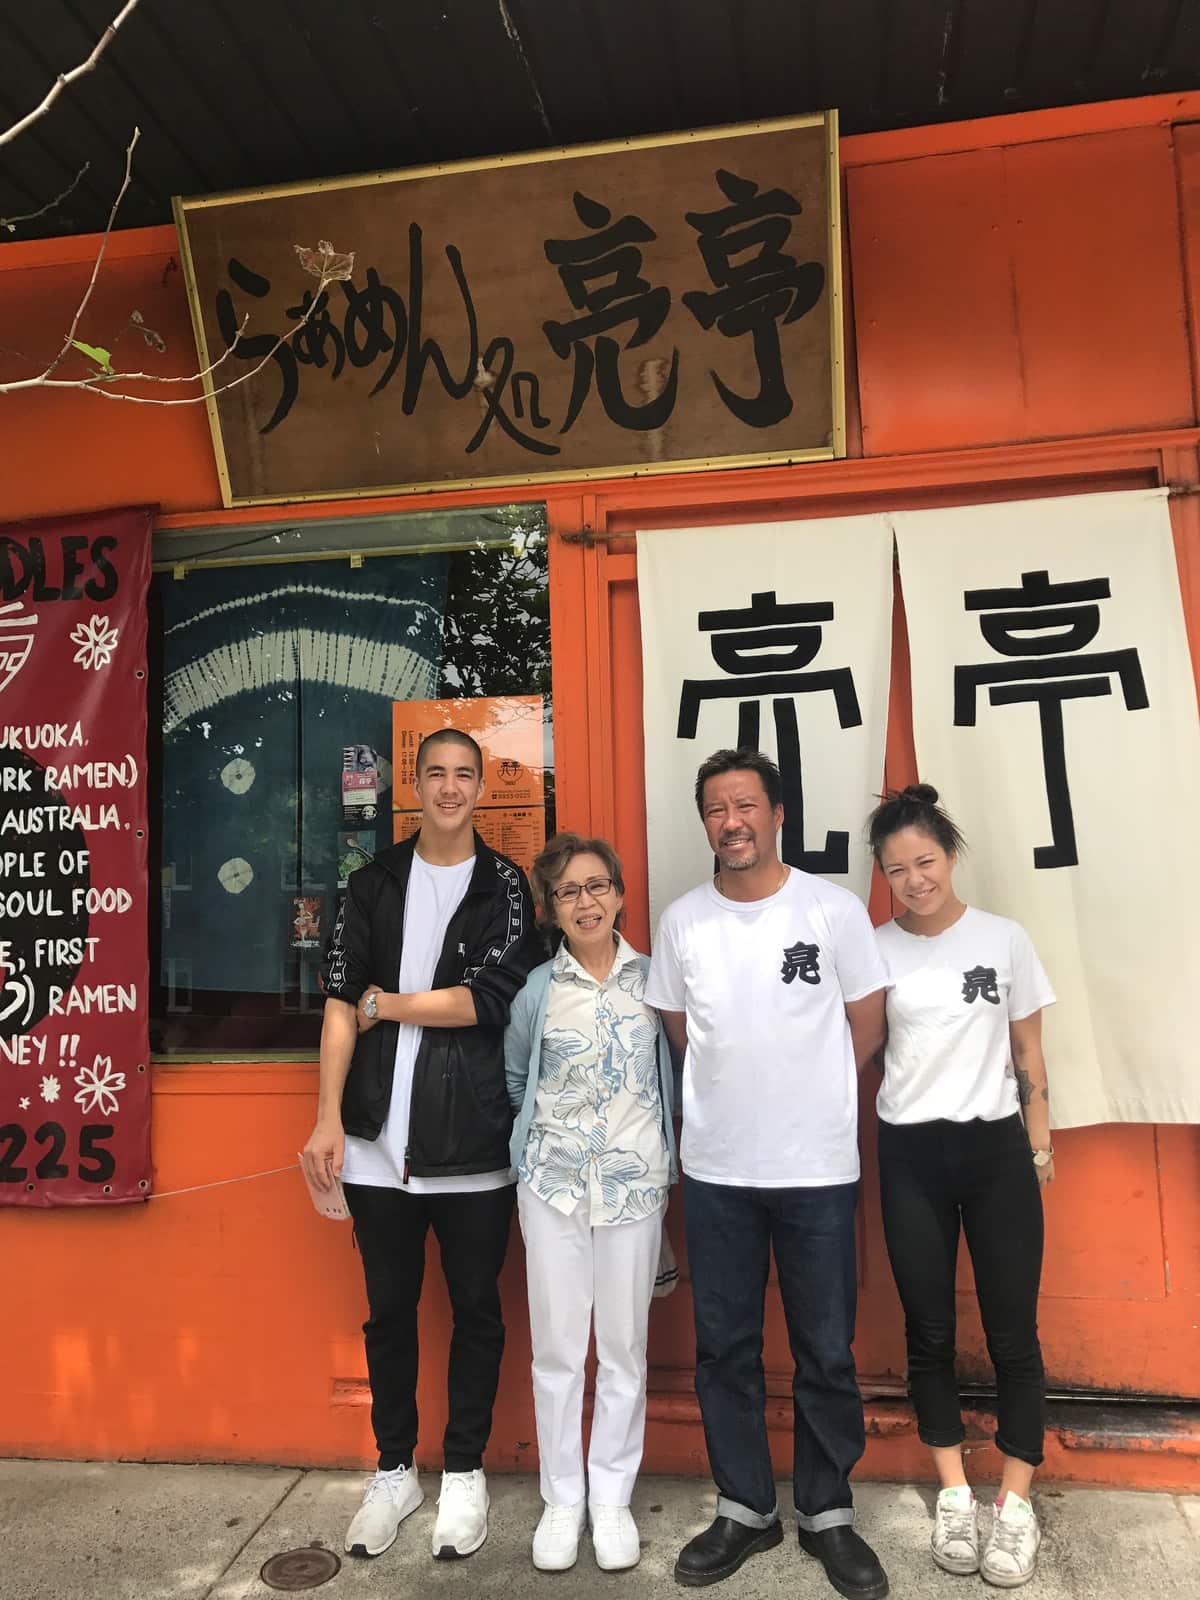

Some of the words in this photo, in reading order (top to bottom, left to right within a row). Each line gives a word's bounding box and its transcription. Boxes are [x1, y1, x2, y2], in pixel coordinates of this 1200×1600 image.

[0, 766, 32, 792] RK
[1, 803, 131, 836] AUSTRALIA.
[0, 851, 46, 878] PLE
[58, 849, 91, 876] OF
[72, 887, 133, 915] FOOD
[35, 937, 101, 968] FIRST
[49, 983, 137, 1016] RAMEN
[0, 1120, 116, 1184] 225
